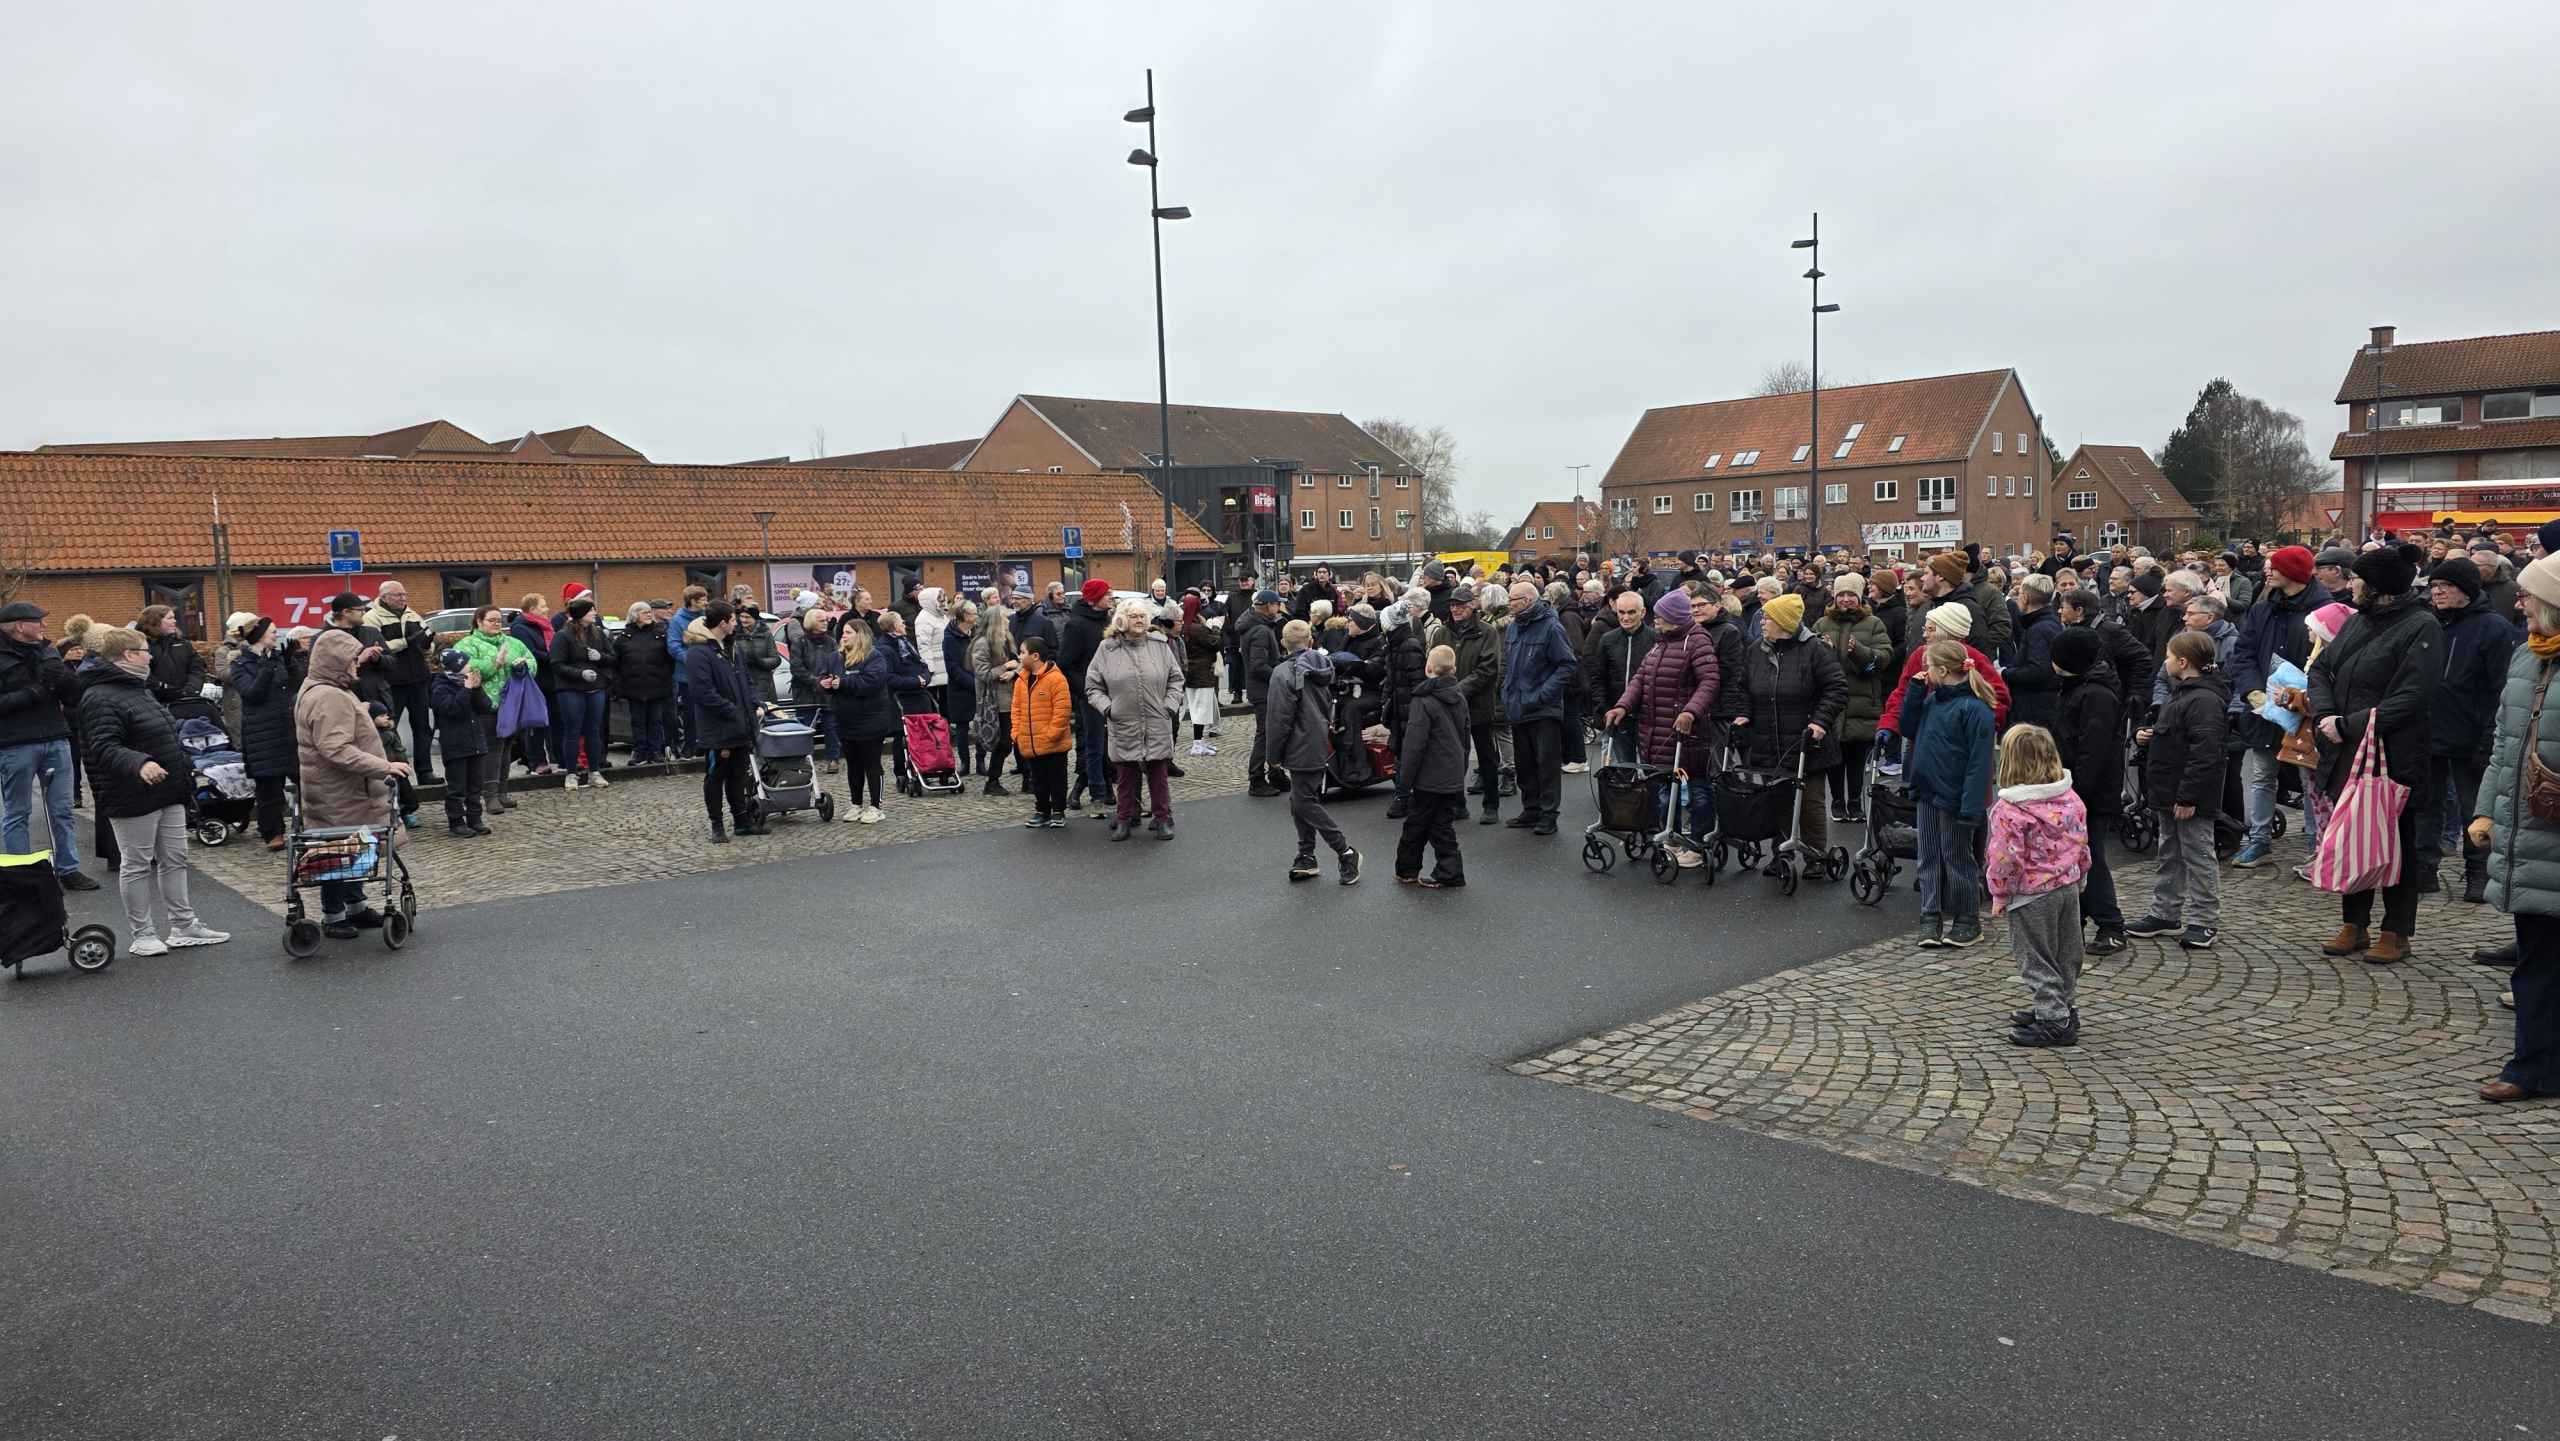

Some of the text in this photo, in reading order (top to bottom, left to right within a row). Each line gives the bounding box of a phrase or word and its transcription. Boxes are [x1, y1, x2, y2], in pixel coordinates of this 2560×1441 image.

[1067, 529, 1078, 544] P
[1881, 525, 1911, 541] PLAZA
[1913, 523, 1941, 539] PIZZA
[335, 534, 354, 554] P
